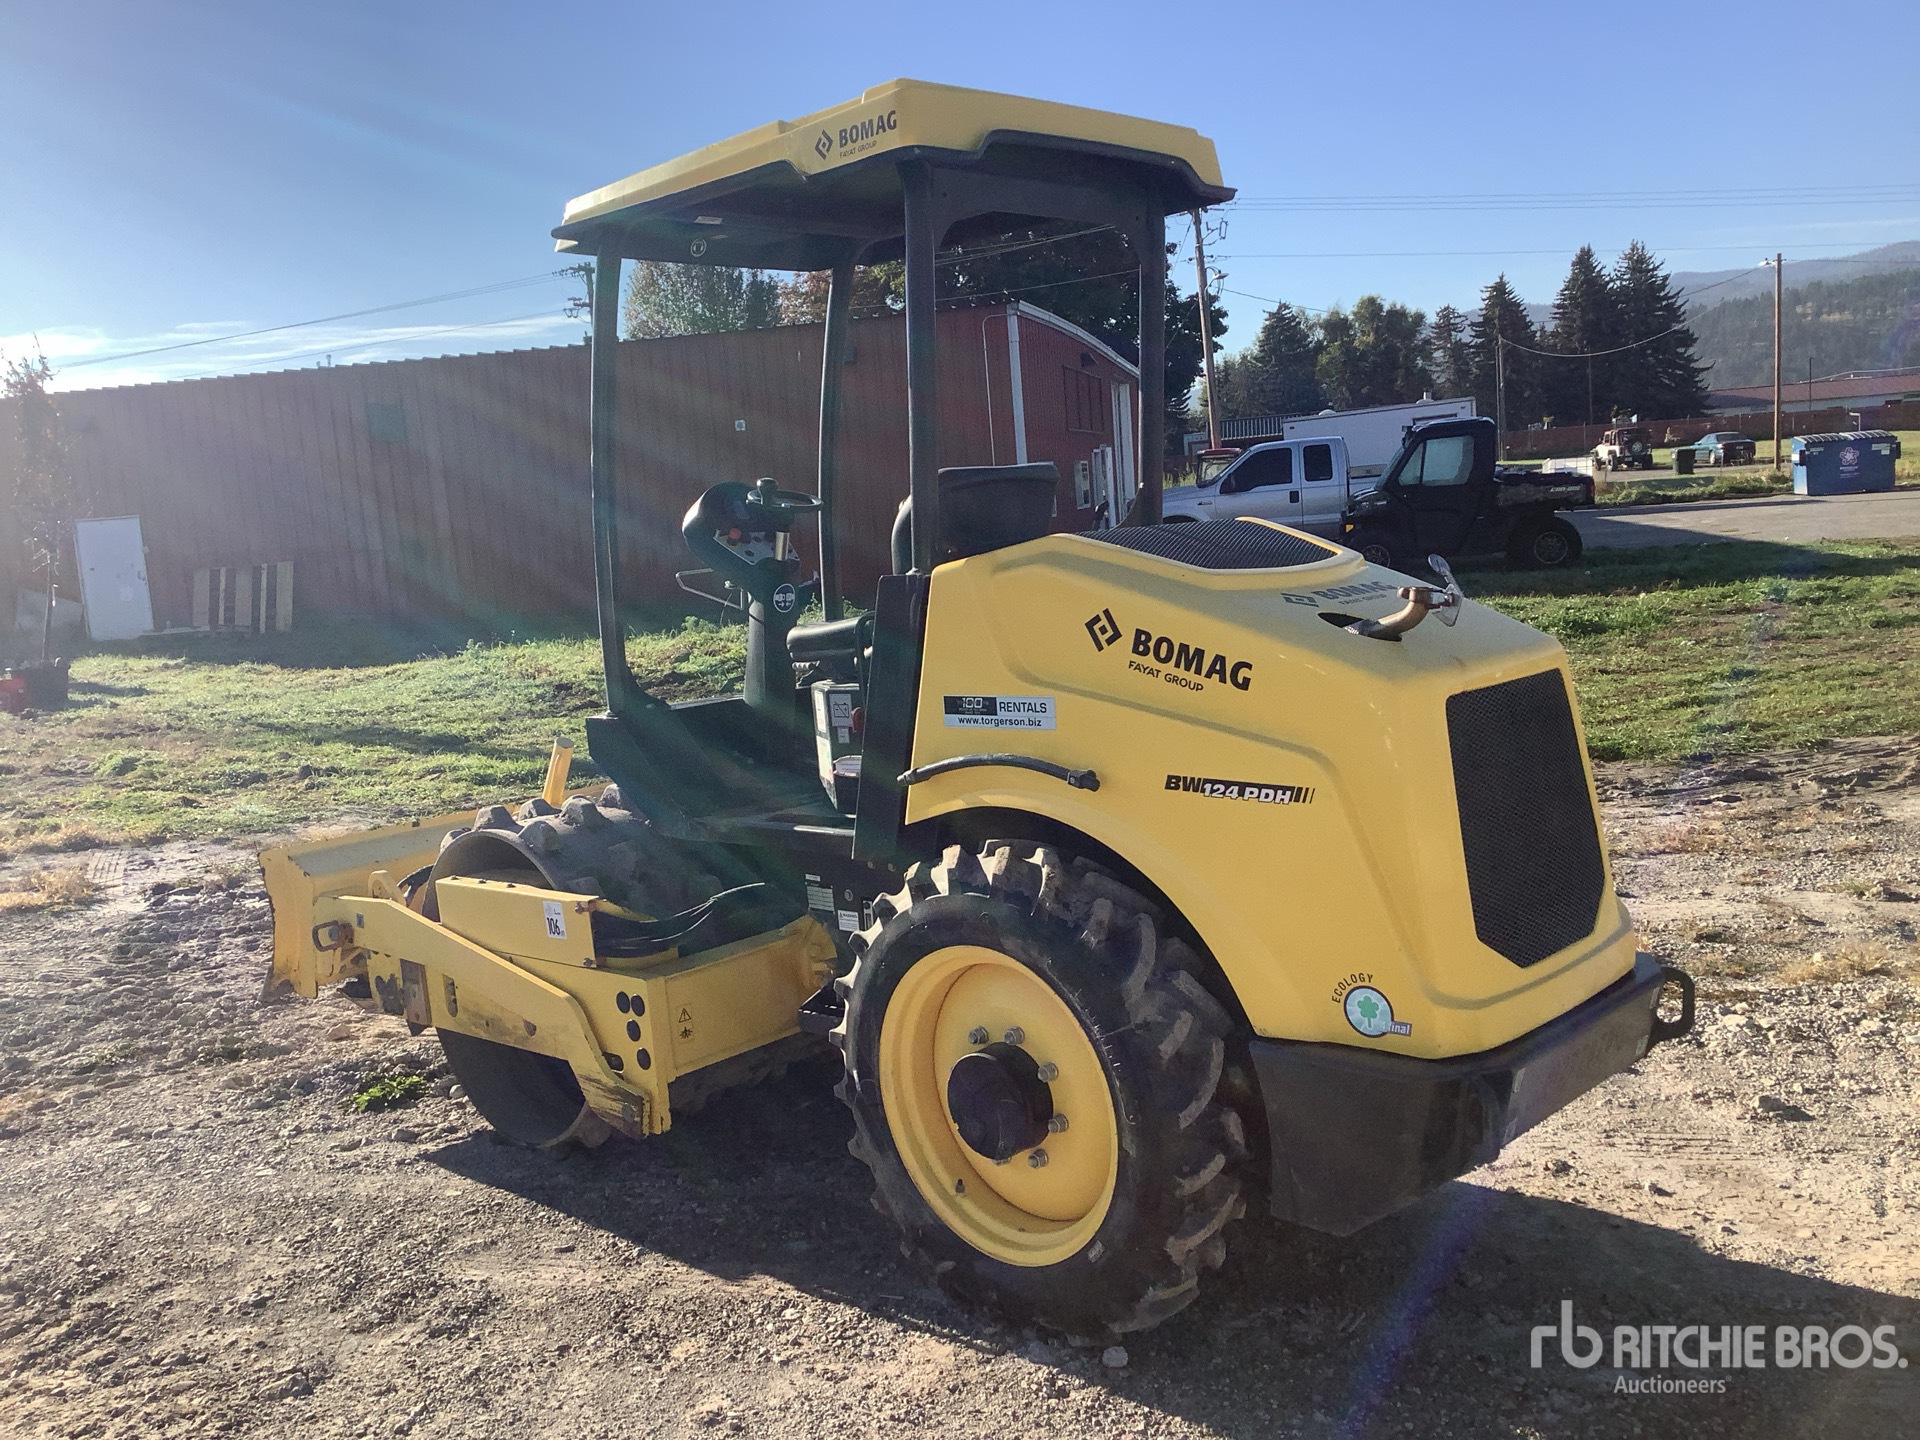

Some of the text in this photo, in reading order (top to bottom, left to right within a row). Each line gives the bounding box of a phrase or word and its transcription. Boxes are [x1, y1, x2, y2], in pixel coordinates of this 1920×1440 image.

[838, 109, 898, 149] BOMAG
[839, 139, 878, 158] FAYAT GROUP
[1311, 581, 1398, 600] BOMAG
[1132, 628, 1253, 691] BOMAG
[1128, 660, 1204, 692] FAYAT GROUP
[962, 697, 1047, 714] 100 RENTALS
[958, 716, 1042, 728] www.torgerson.biz
[1243, 787, 1292, 805] PDH
[547, 917, 561, 935] 106
[1331, 972, 1373, 1003] ECOLOGY
